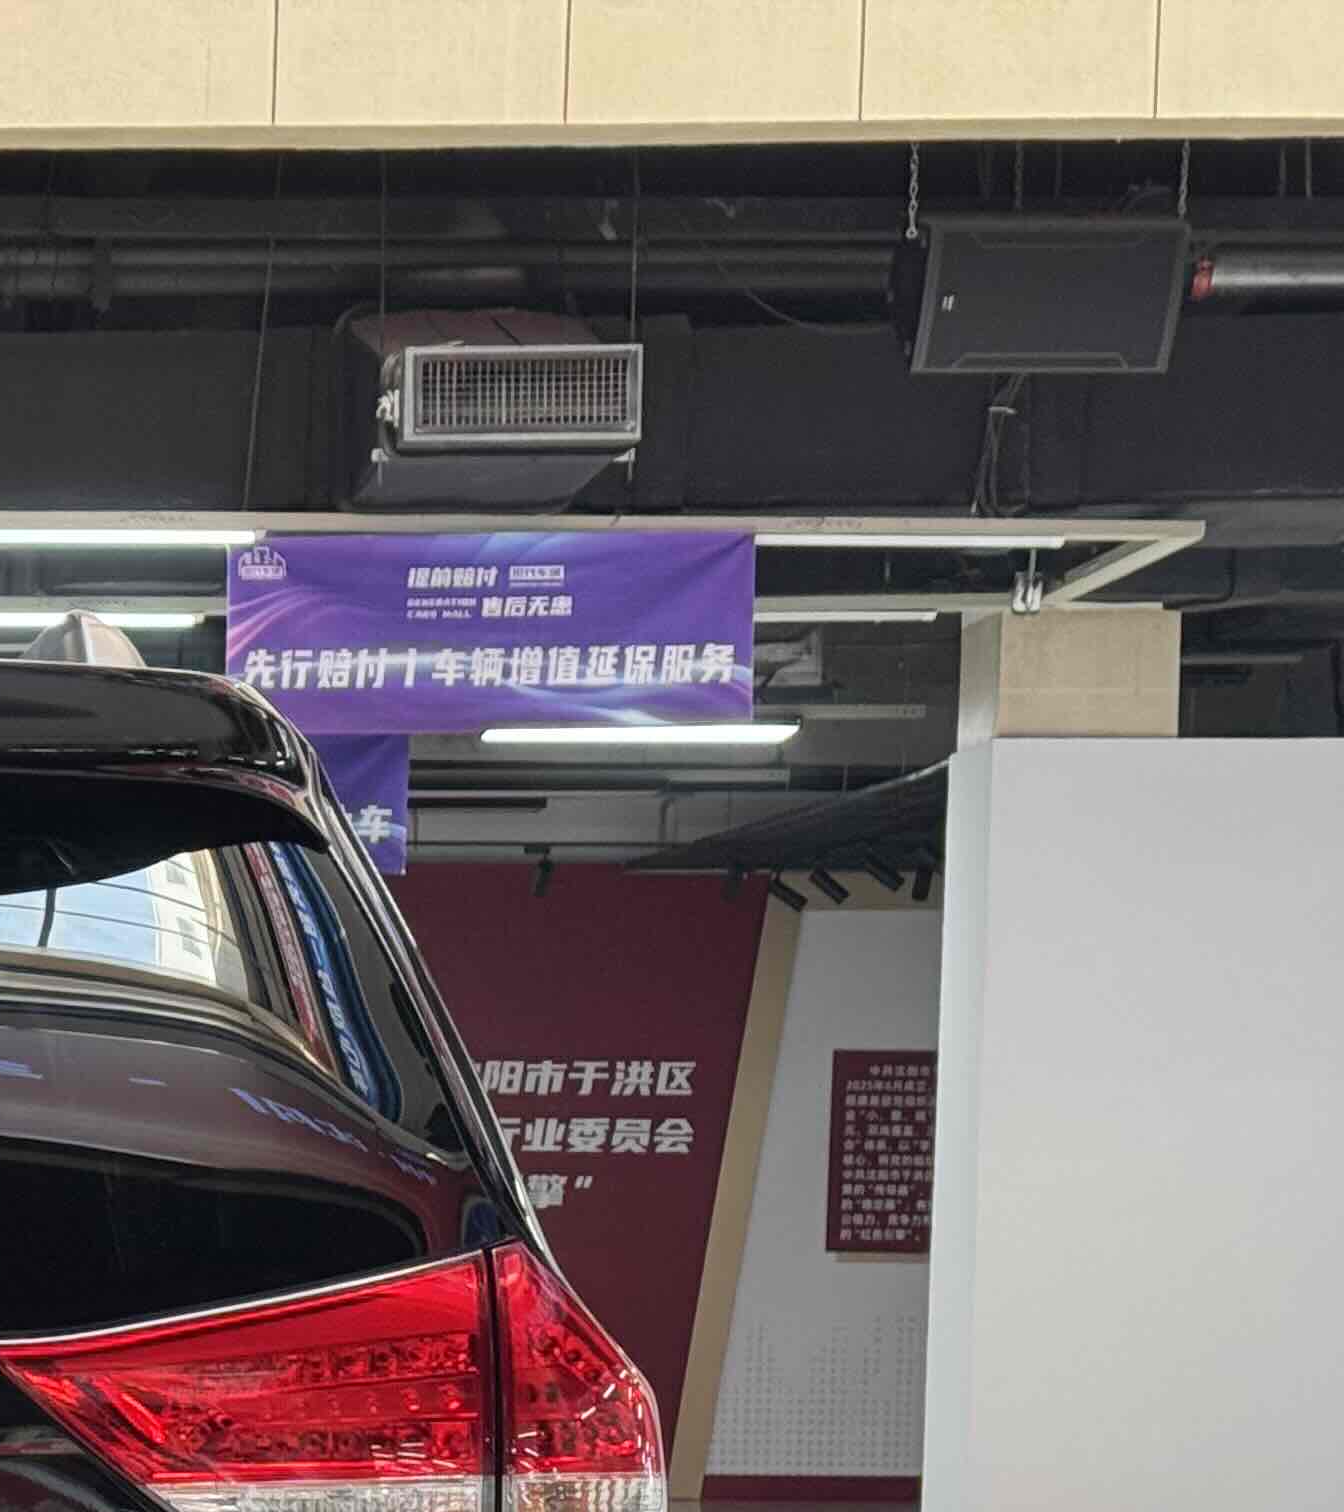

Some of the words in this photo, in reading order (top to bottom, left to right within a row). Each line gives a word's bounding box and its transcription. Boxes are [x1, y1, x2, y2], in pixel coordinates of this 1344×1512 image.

[407, 565, 500, 589] 提前赔付
[473, 1060, 696, 1096] 阳市于洪区
